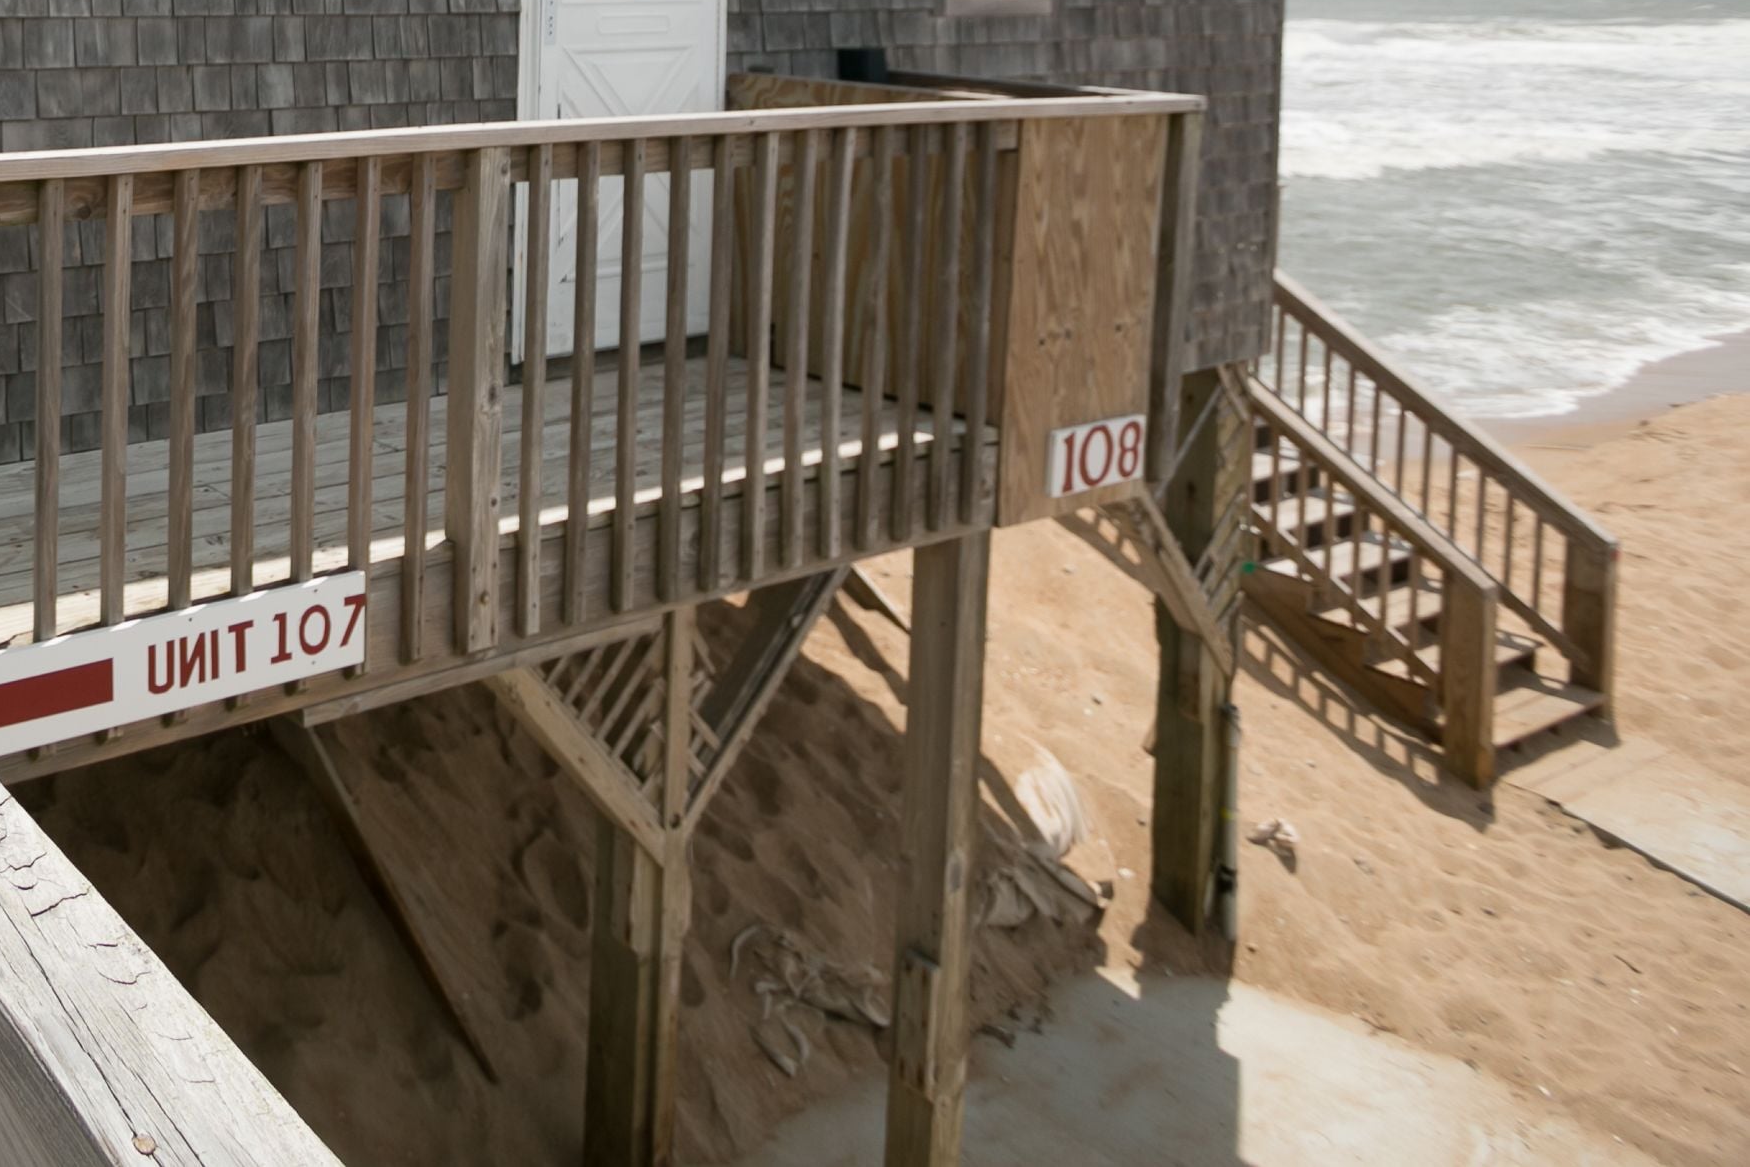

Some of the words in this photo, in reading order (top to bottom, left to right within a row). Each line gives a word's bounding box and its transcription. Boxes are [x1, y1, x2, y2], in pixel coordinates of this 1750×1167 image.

[1062, 420, 1142, 494] 108
[147, 620, 255, 695] UNIT
[270, 593, 367, 665] 107
